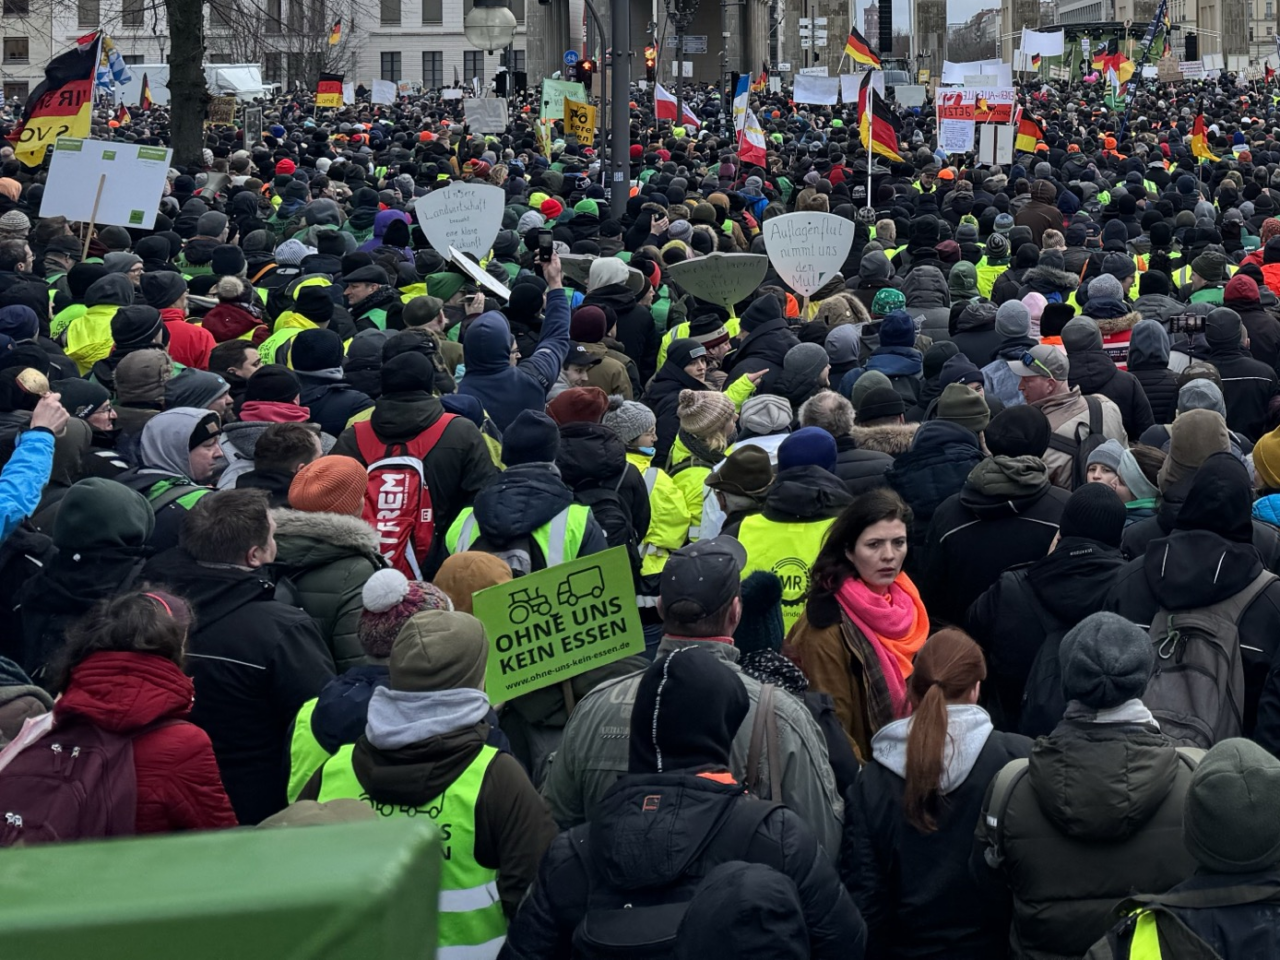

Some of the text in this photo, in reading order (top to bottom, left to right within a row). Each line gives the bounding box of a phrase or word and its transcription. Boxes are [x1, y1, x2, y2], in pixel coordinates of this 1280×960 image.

[442, 189, 476, 200] Unsere
[770, 217, 843, 243] Auflagenflut
[780, 244, 838, 258] nimmt uns
[795, 262, 816, 273] den
[377, 473, 405, 567] XTREM
[495, 596, 622, 653] OHNE UNS
[499, 617, 627, 676] KEIN ESSEN
[505, 641, 631, 690] www.ohne-uns-kein-essen.de
